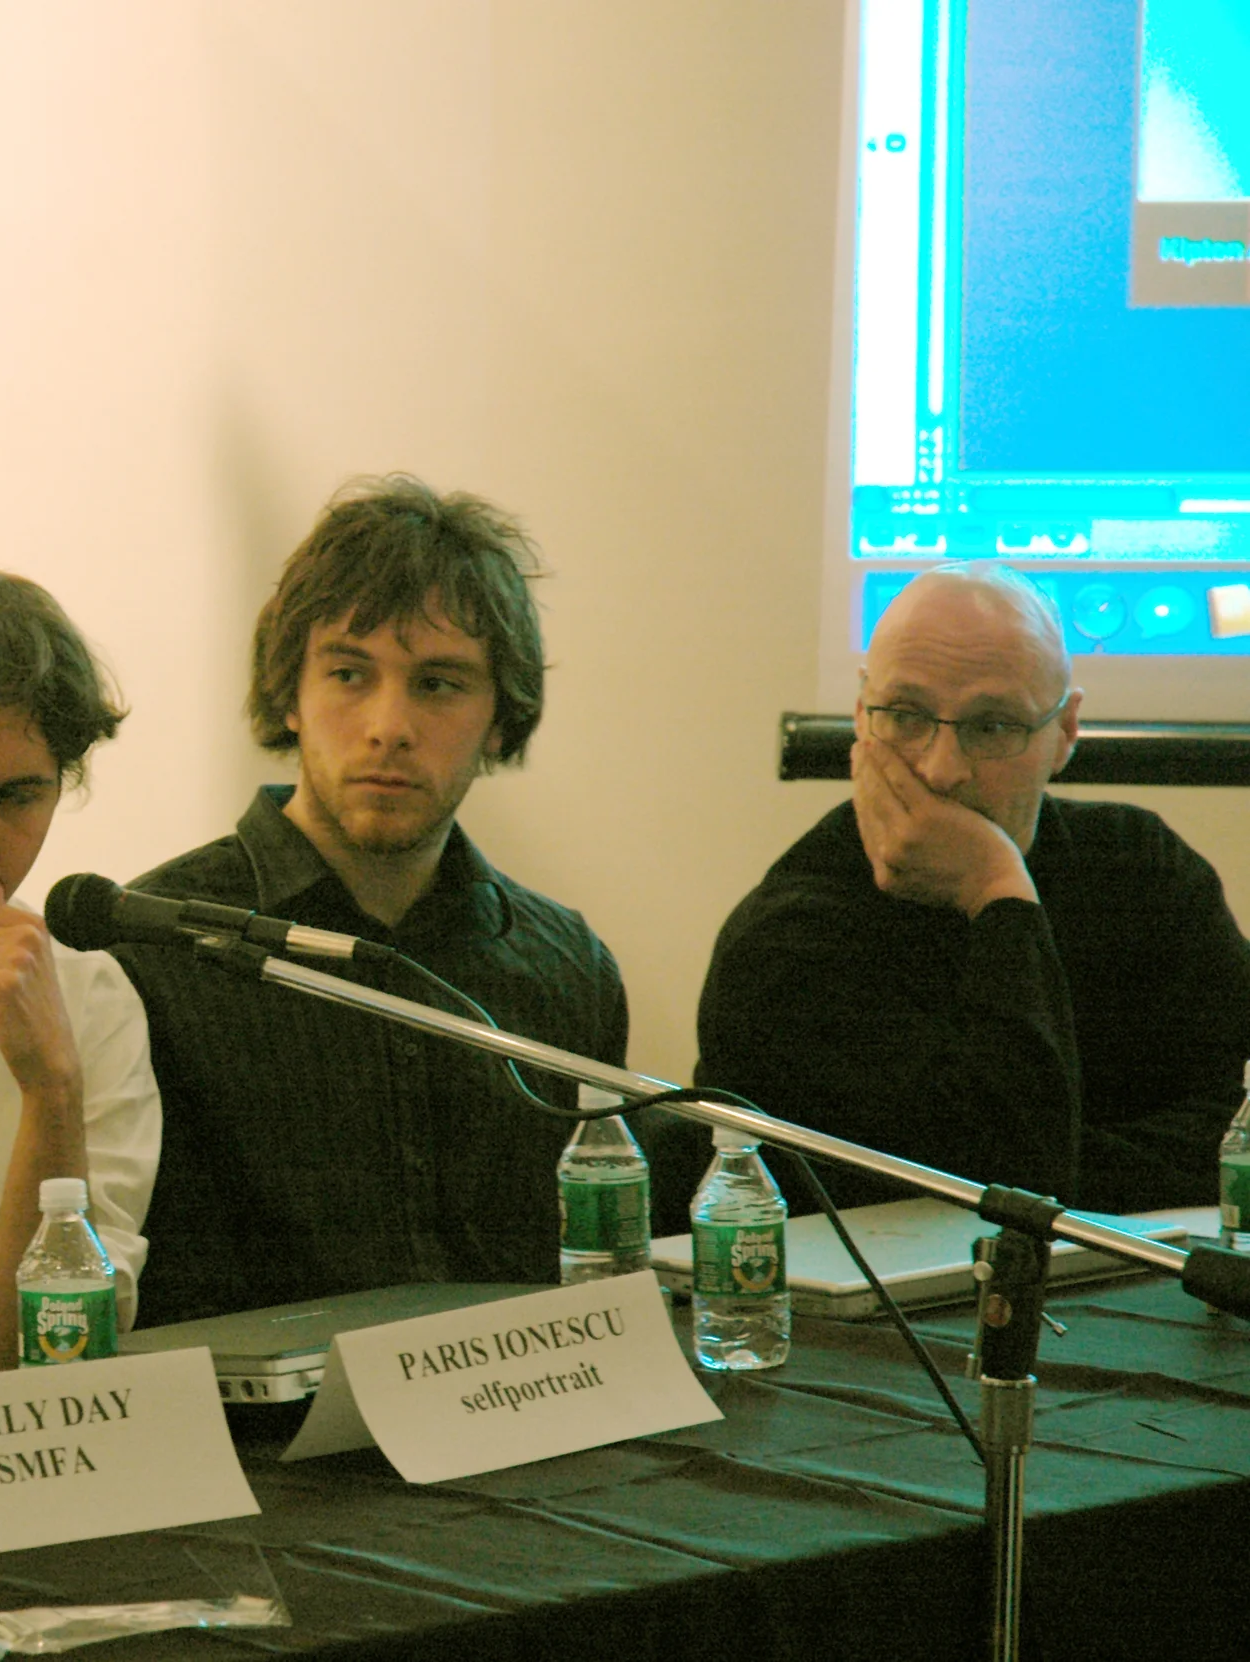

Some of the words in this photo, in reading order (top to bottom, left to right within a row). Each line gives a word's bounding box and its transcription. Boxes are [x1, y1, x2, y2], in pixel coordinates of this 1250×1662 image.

[731, 1244, 779, 1267] Spring
[37, 1311, 88, 1335] Spring
[398, 1337, 489, 1381] PARIS
[494, 1307, 625, 1362] IONESCU
[58, 1388, 132, 1427] DAY
[460, 1362, 604, 1414] selfportrait
